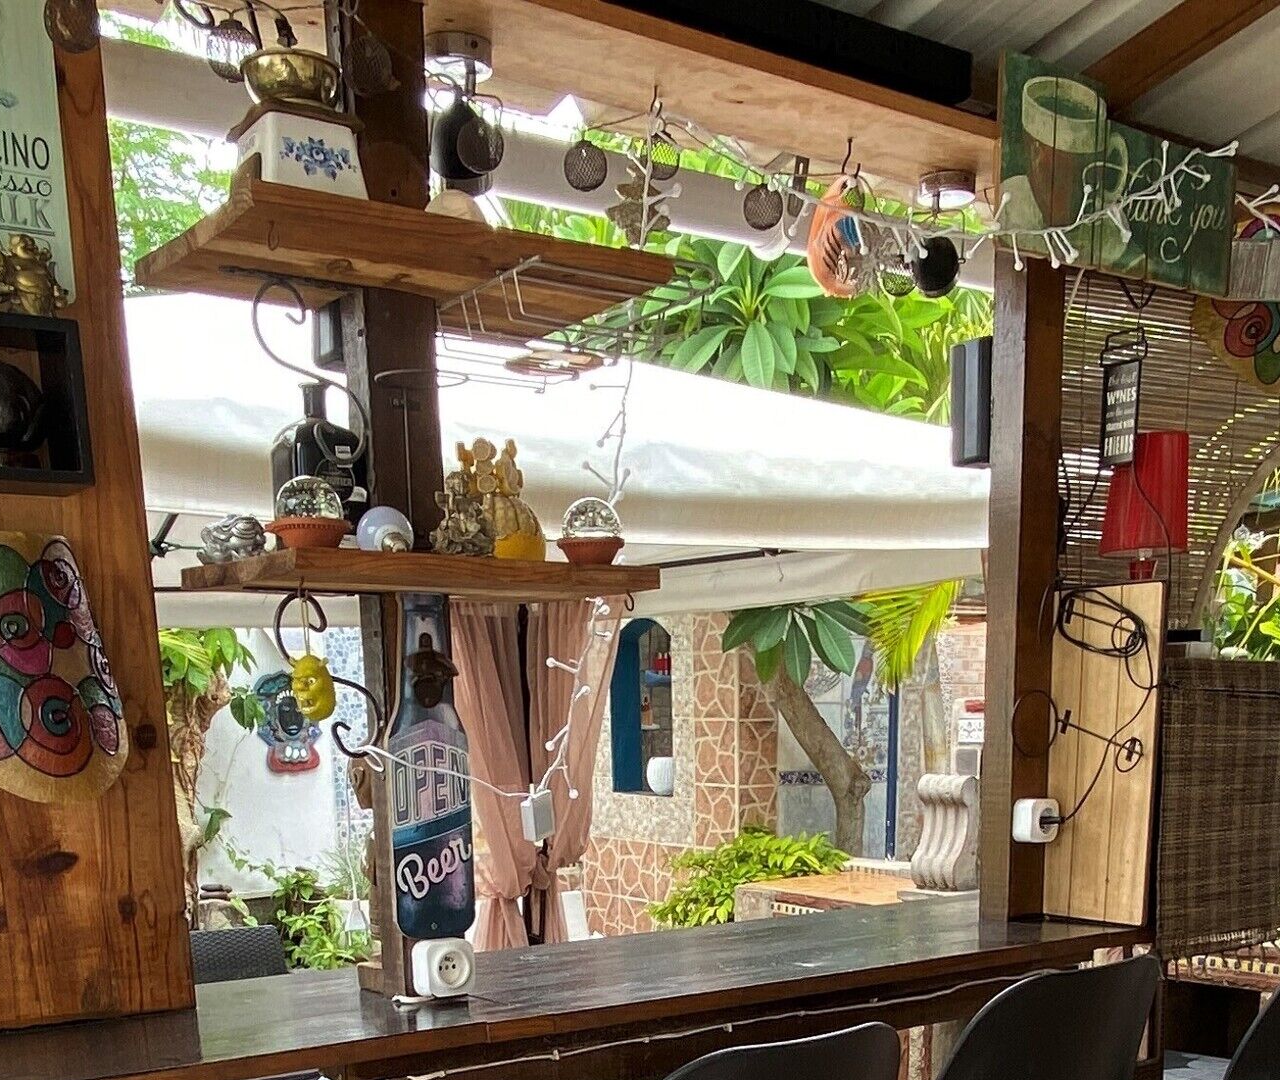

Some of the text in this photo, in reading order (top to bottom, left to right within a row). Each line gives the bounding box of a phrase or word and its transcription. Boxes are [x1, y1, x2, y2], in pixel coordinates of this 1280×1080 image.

[1160, 202, 1226, 263] you
[392, 743, 469, 825] OPEN
[396, 837, 472, 899] Beer
